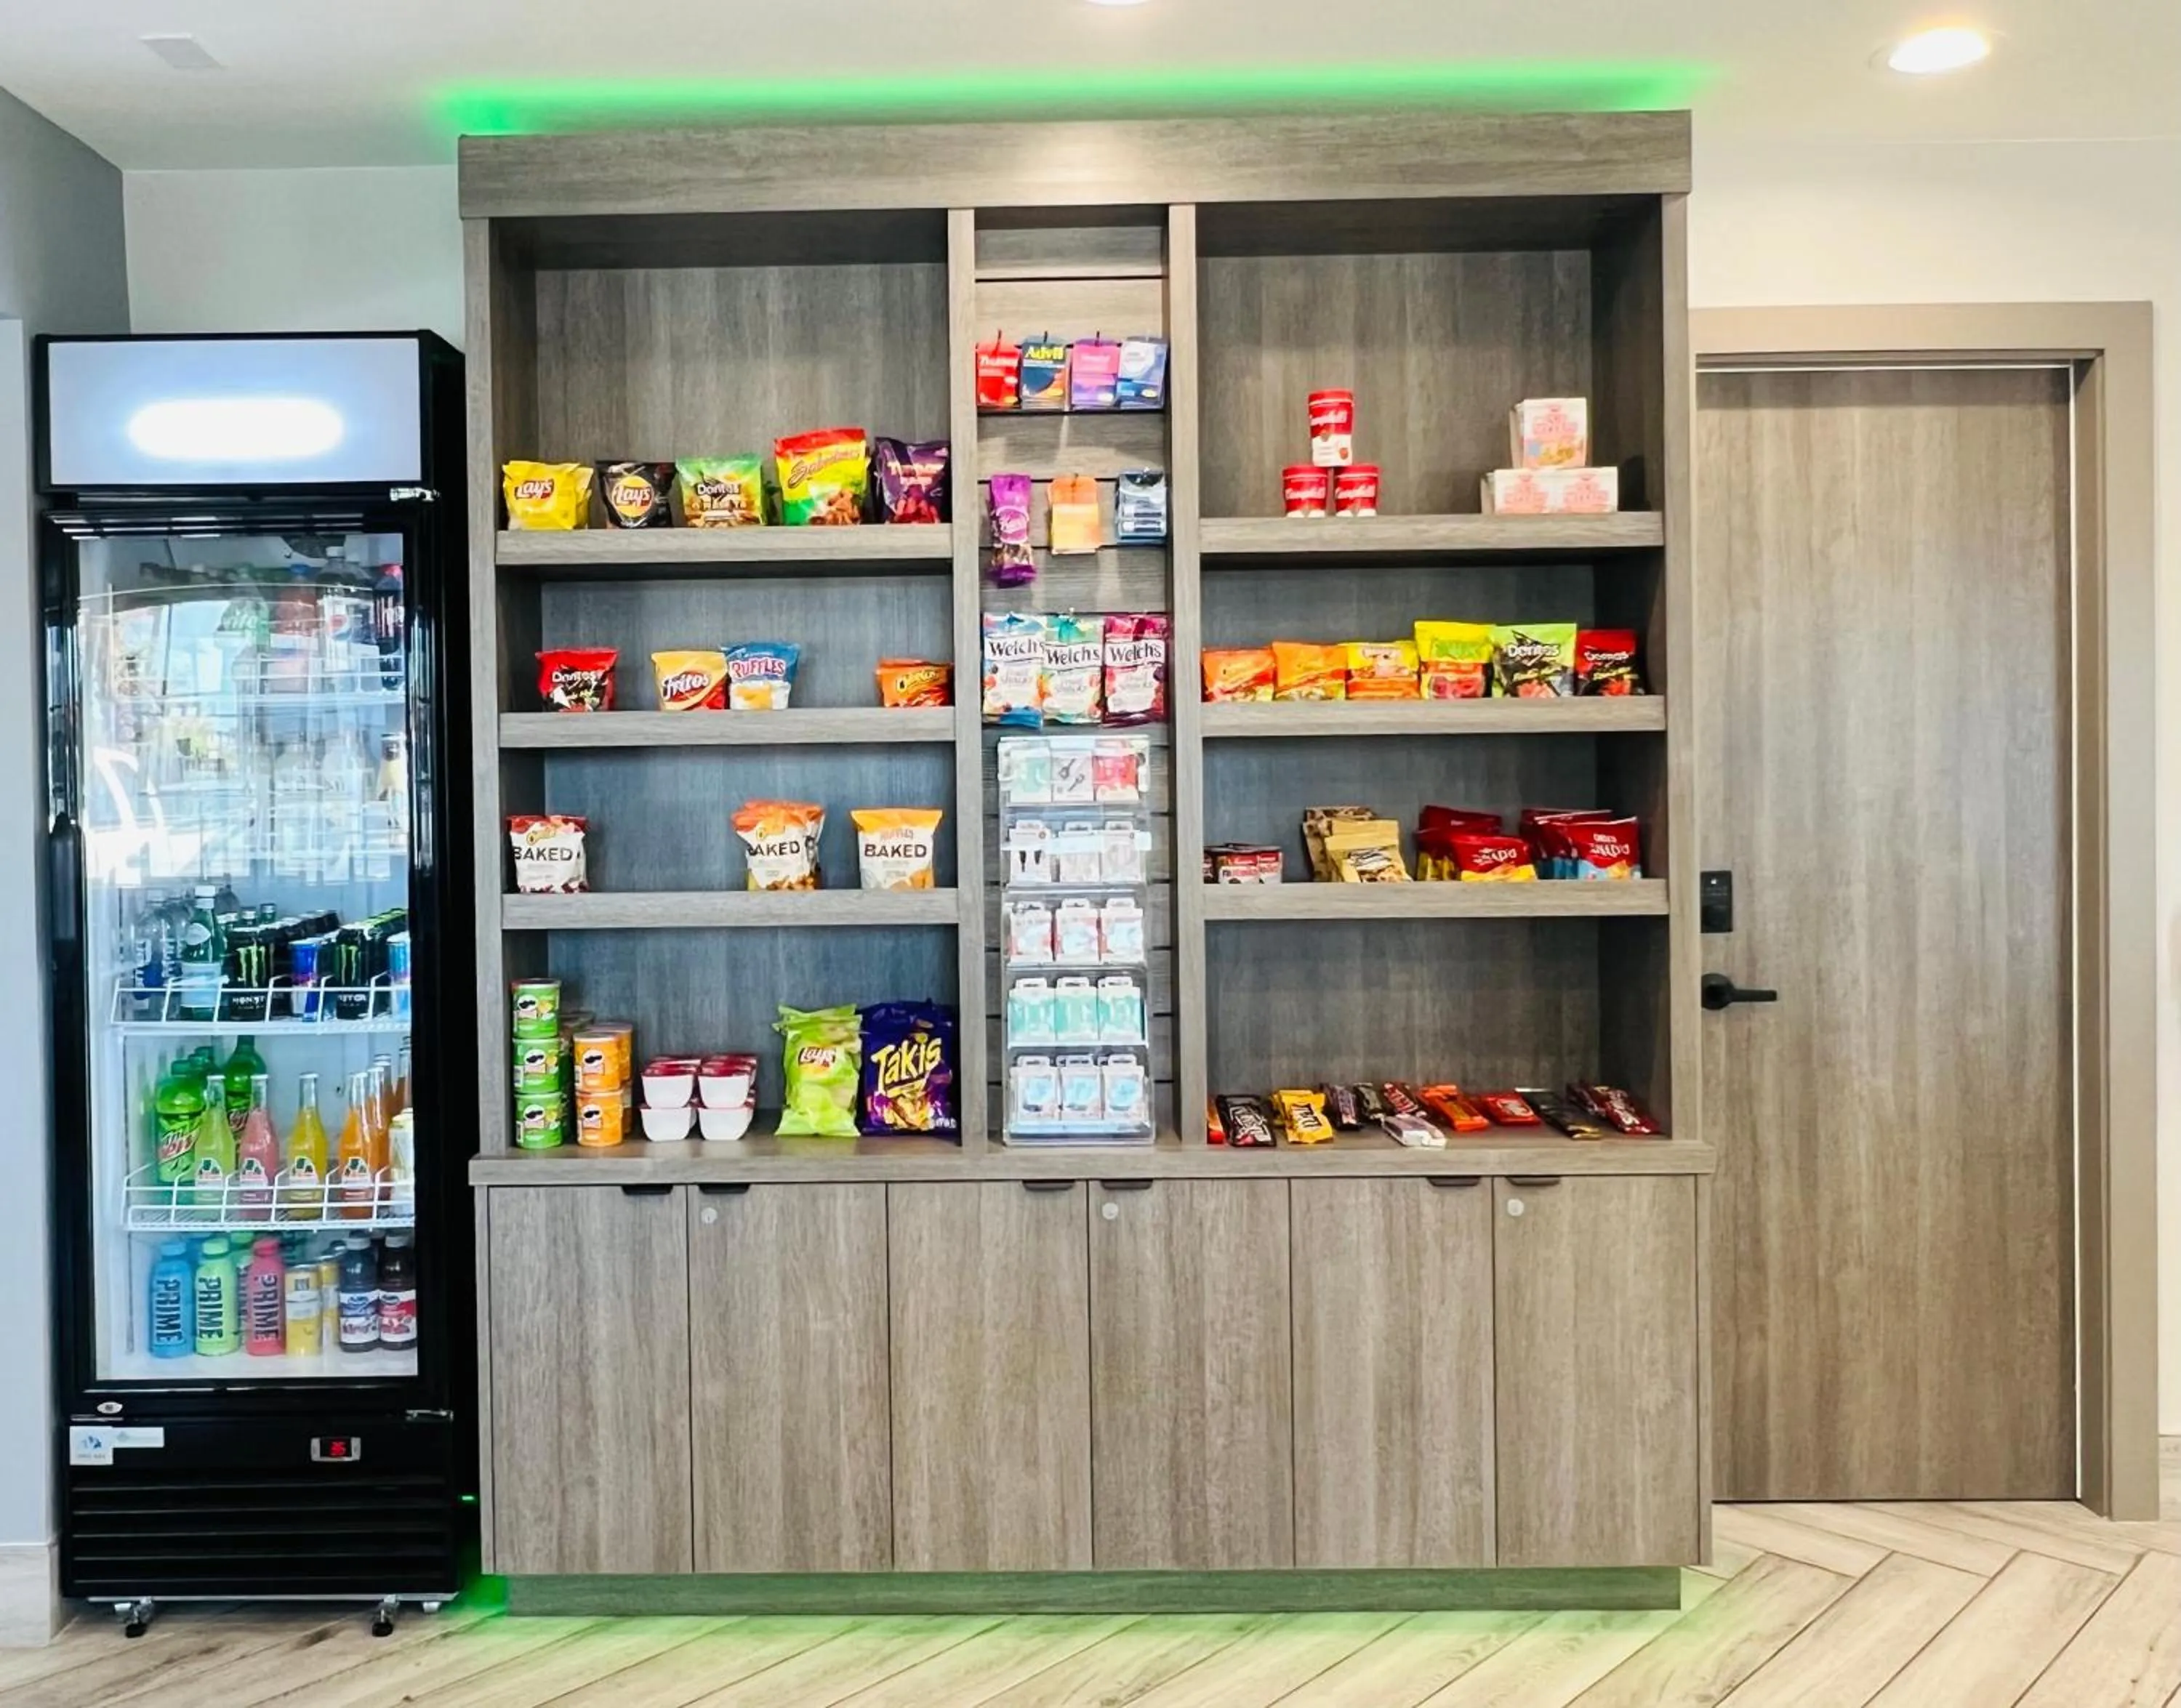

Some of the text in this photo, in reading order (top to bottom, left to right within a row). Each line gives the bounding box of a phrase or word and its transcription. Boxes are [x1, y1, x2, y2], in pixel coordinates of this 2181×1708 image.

[663, 673, 710, 699] Fritos
[730, 658, 786, 678] RUFFLES
[513, 846, 573, 861] BAKED
[864, 844, 928, 858] BAKED
[871, 1037, 942, 1095] Takis
[156, 1278, 182, 1342] PRIME
[198, 1276, 223, 1339] PRIME
[253, 1274, 279, 1341] PRIME
